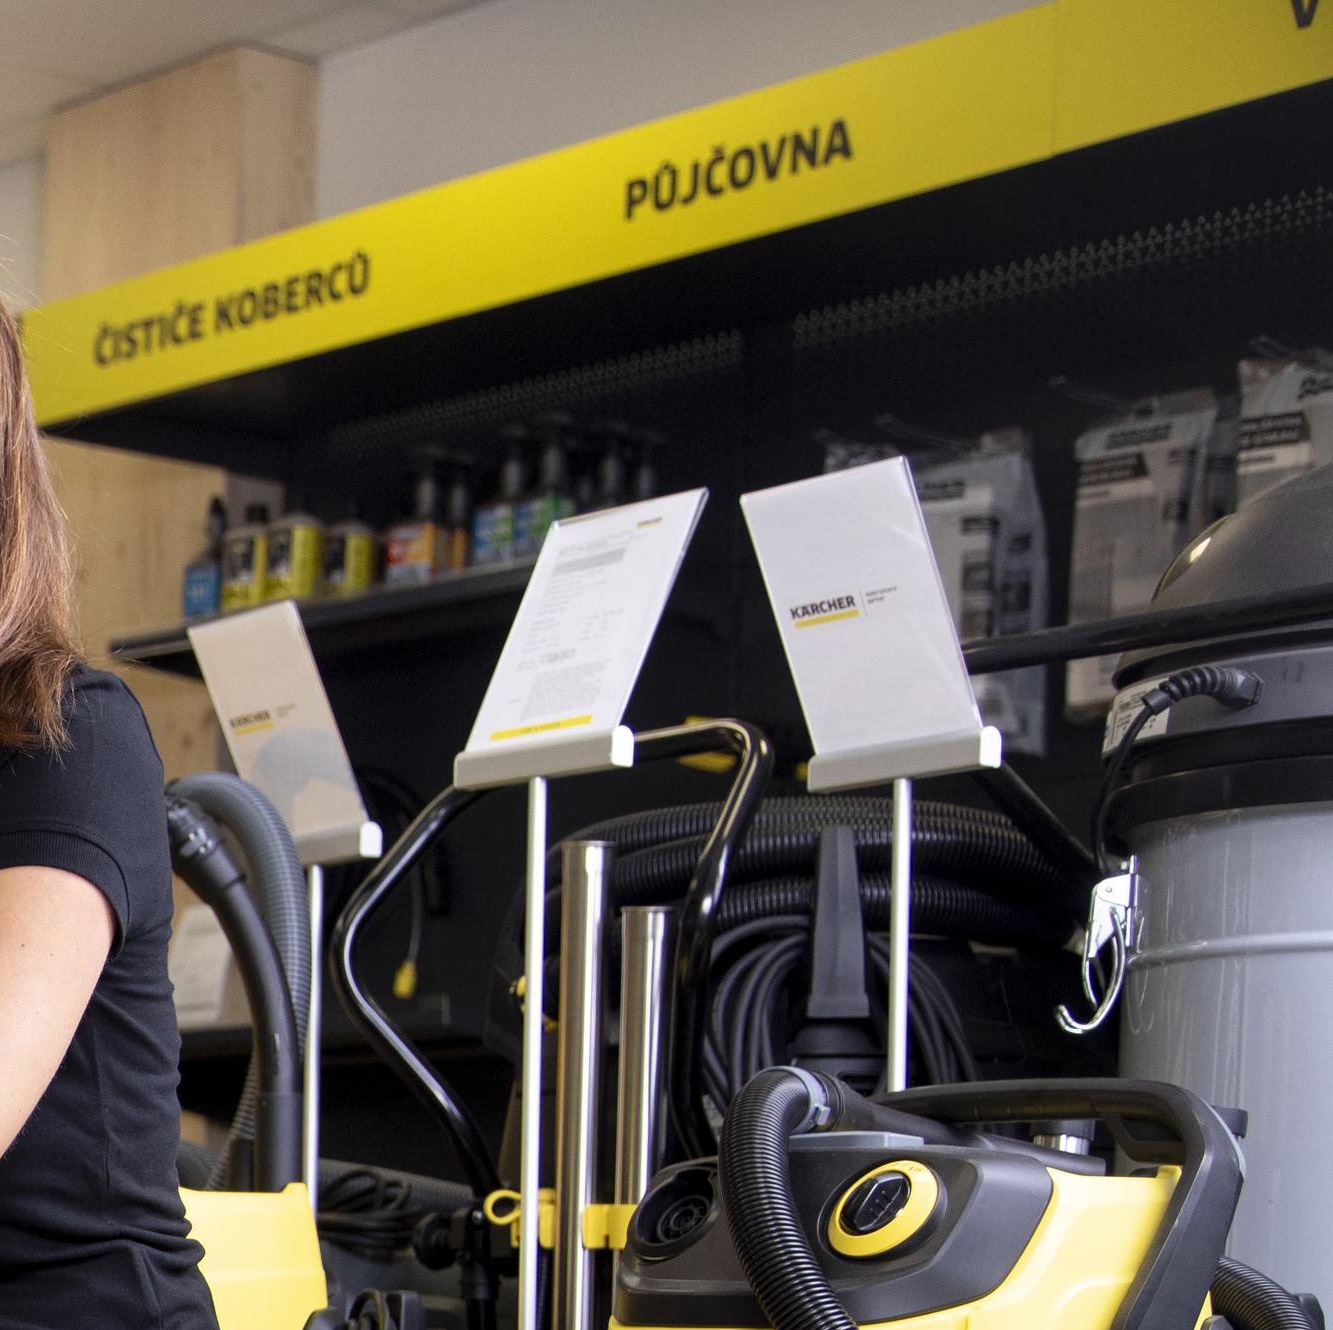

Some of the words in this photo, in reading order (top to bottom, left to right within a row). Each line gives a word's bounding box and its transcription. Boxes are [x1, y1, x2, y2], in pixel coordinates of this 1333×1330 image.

[624, 117, 854, 221] PŮJČOVNA
[93, 296, 207, 368] ČISTIČE
[214, 249, 372, 333] KOBERCŮ
